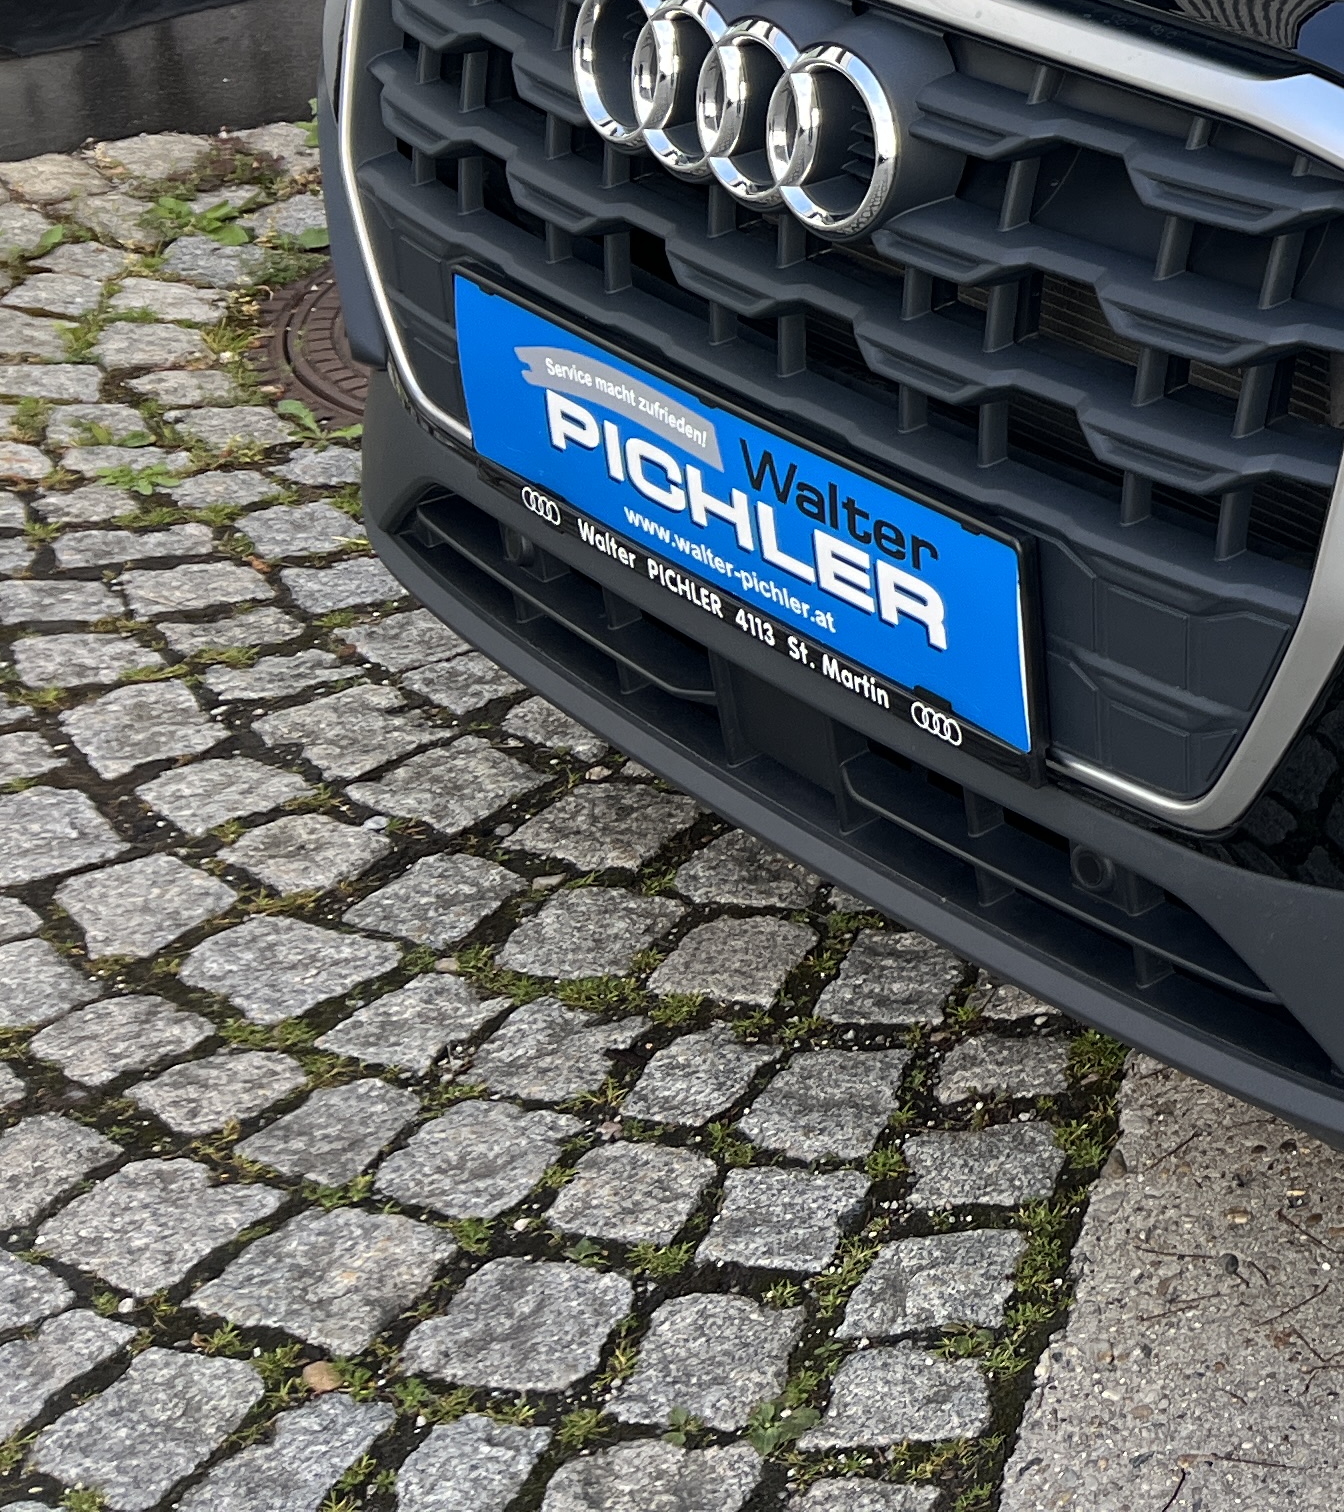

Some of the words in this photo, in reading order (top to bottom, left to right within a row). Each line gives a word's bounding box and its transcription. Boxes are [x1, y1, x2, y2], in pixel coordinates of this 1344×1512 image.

[545, 357, 593, 387] Service
[595, 376, 637, 407] macht
[638, 396, 708, 448] zufrieden!
[546, 388, 948, 651] PICHLER
[622, 505, 837, 634] www.walter-pichler.at
[739, 437, 939, 570] Walter
[577, 518, 636, 569] Walter
[647, 557, 724, 619] PICHLER
[735, 608, 776, 647] 4113
[787, 635, 815, 669] St.
[822, 653, 890, 710] Martin
